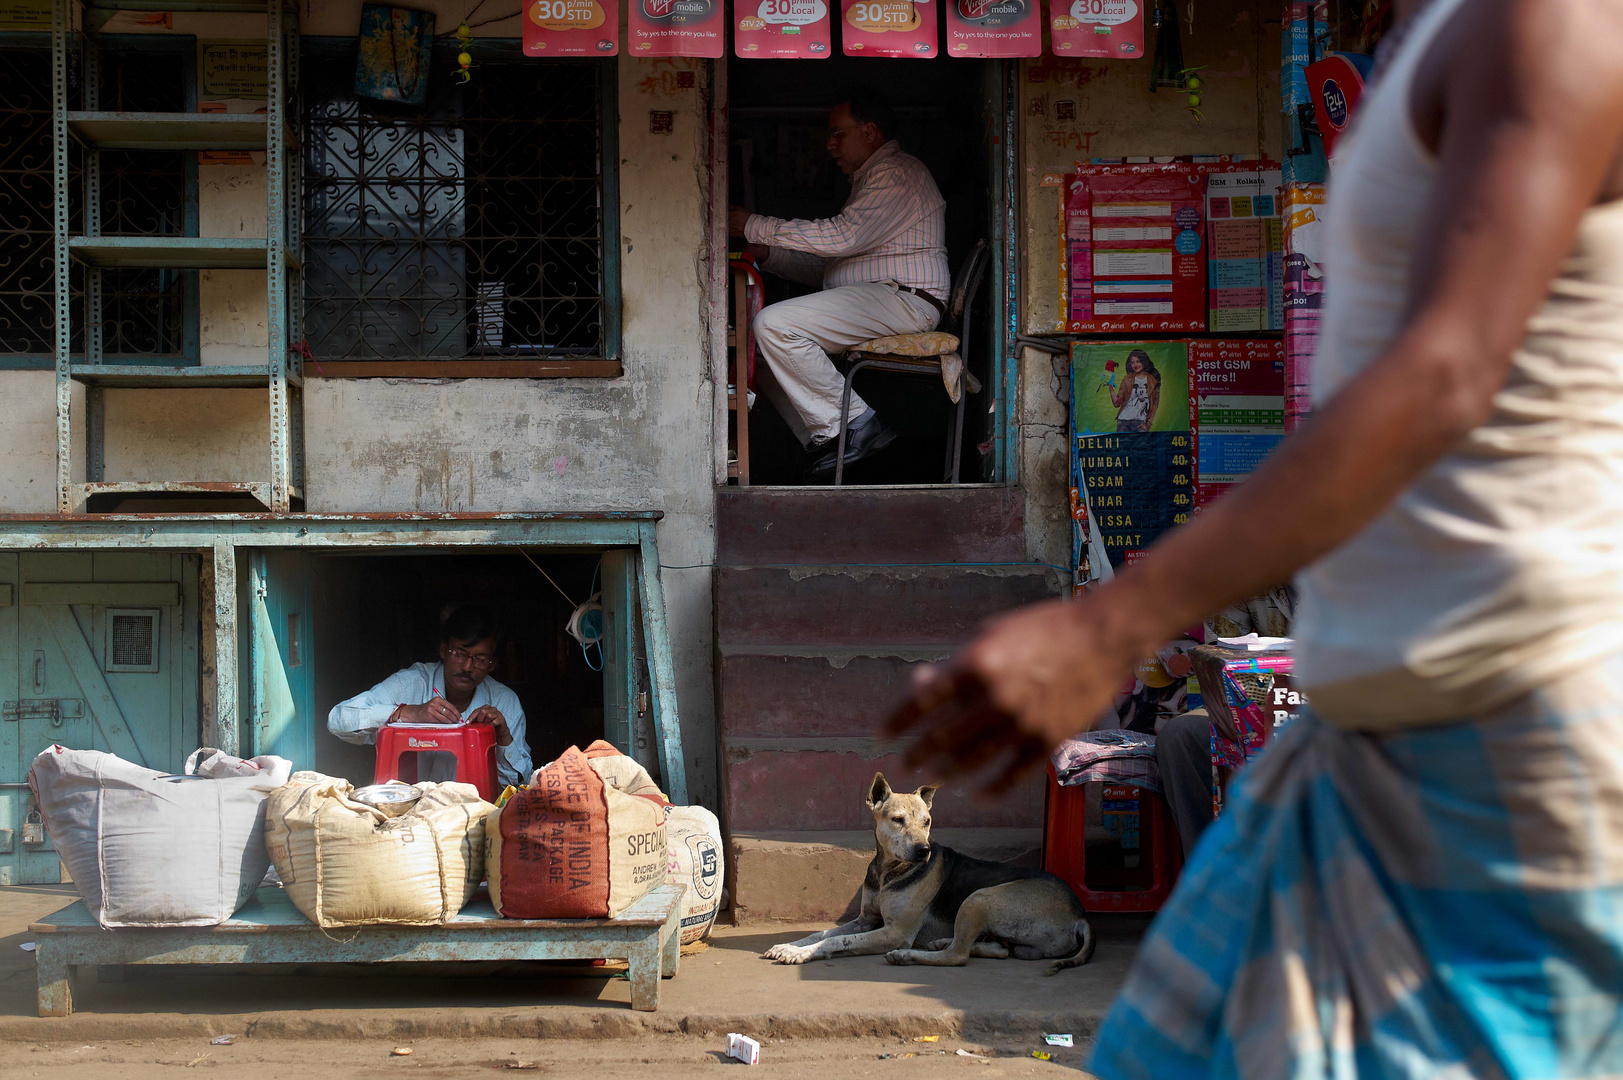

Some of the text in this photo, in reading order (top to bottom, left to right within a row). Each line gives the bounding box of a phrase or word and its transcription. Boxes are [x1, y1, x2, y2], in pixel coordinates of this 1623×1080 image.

[538, 0, 594, 20] 30 p/min
[766, 0, 790, 15] 30
[856, 3, 908, 22] 30 p/min
[992, 5, 1018, 13] mobile
[1079, 0, 1102, 14] 30
[567, 9, 592, 20] STD
[883, 12, 908, 22] STD
[954, 31, 964, 39] Say
[1197, 360, 1250, 369] Best GSM
[1079, 437, 1119, 449] DELHI
[1080, 456, 1129, 468] MUMBAI
[1089, 476, 1123, 488] SSAM
[1090, 496, 1122, 507] IHAR
[1100, 515, 1132, 526] ISSA
[1102, 535, 1141, 546] ARAT
[545, 767, 565, 884] LESALE PACKAGE
[570, 811, 591, 833] OF
[400, 826, 415, 846] TD.
[569, 841, 591, 890] INDIA
